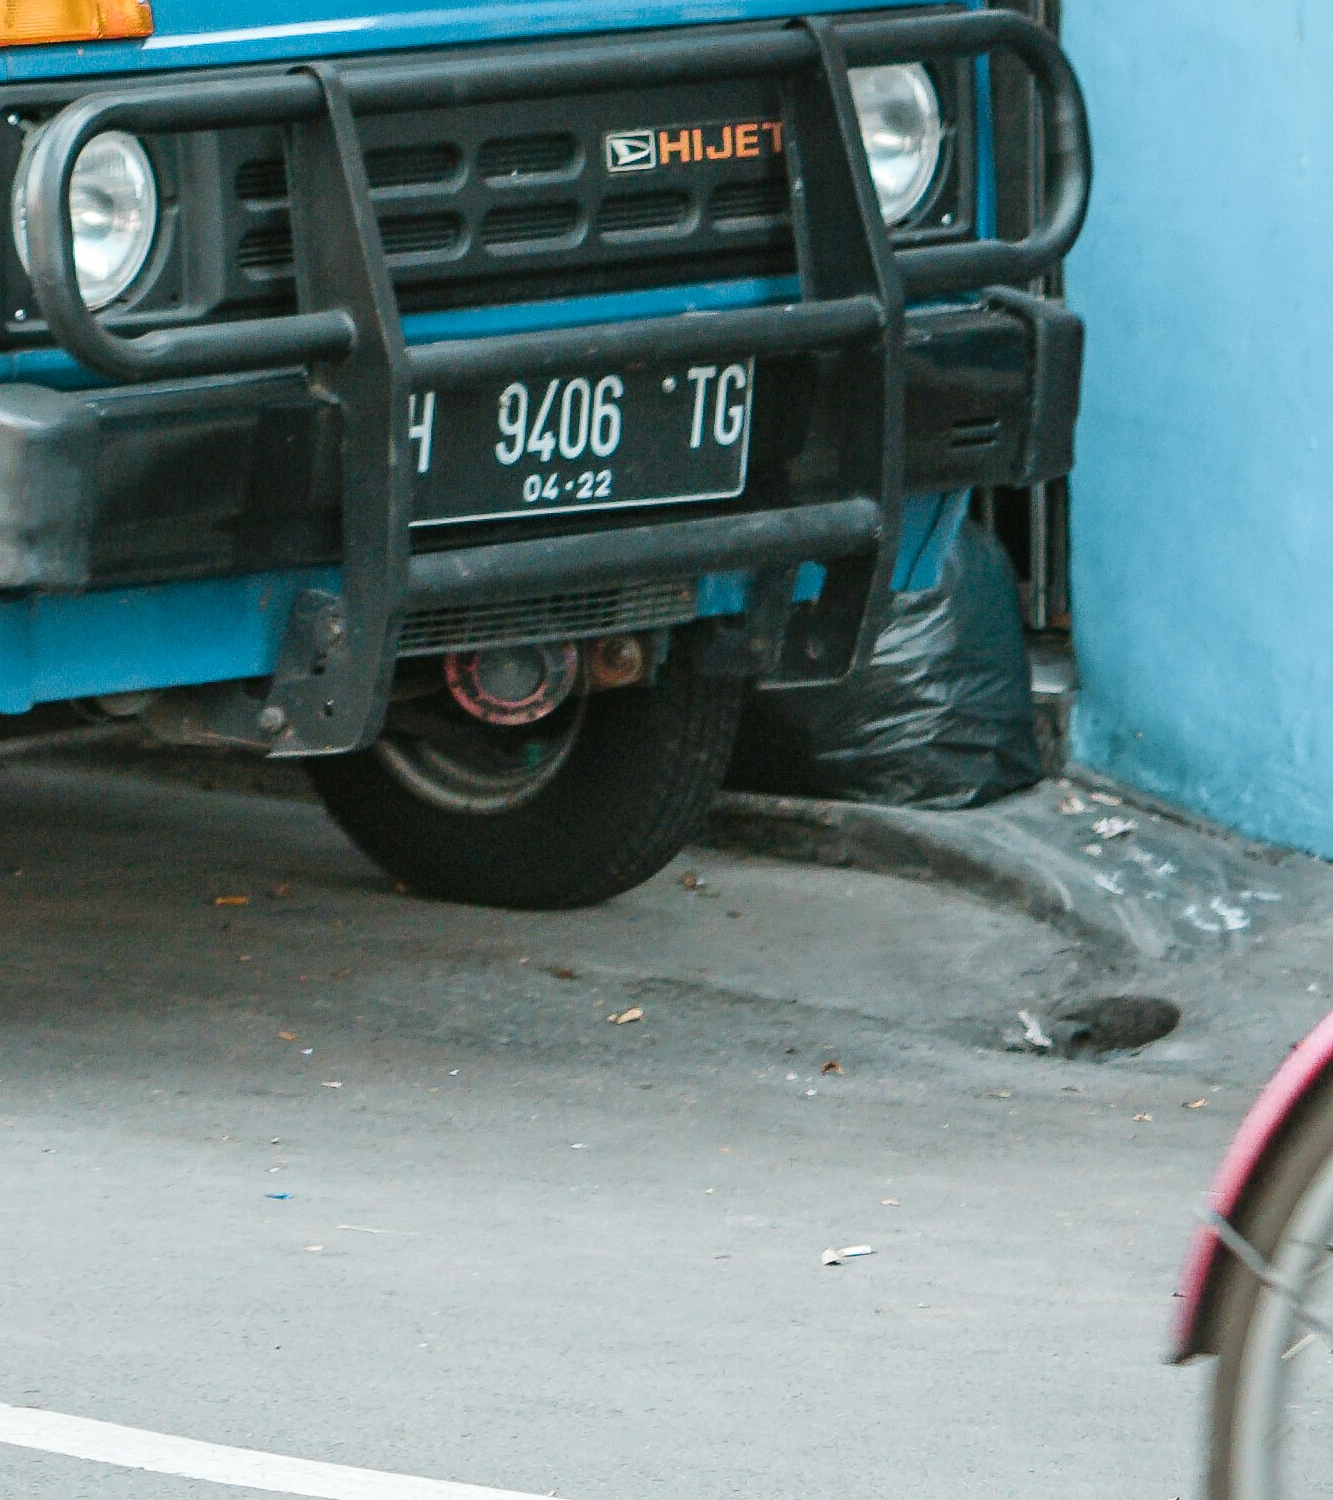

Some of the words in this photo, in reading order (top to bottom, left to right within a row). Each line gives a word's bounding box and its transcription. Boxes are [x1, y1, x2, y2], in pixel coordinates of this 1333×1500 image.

[659, 121, 784, 166] HIJET
[494, 373, 625, 466] 9406
[686, 363, 748, 450] TG
